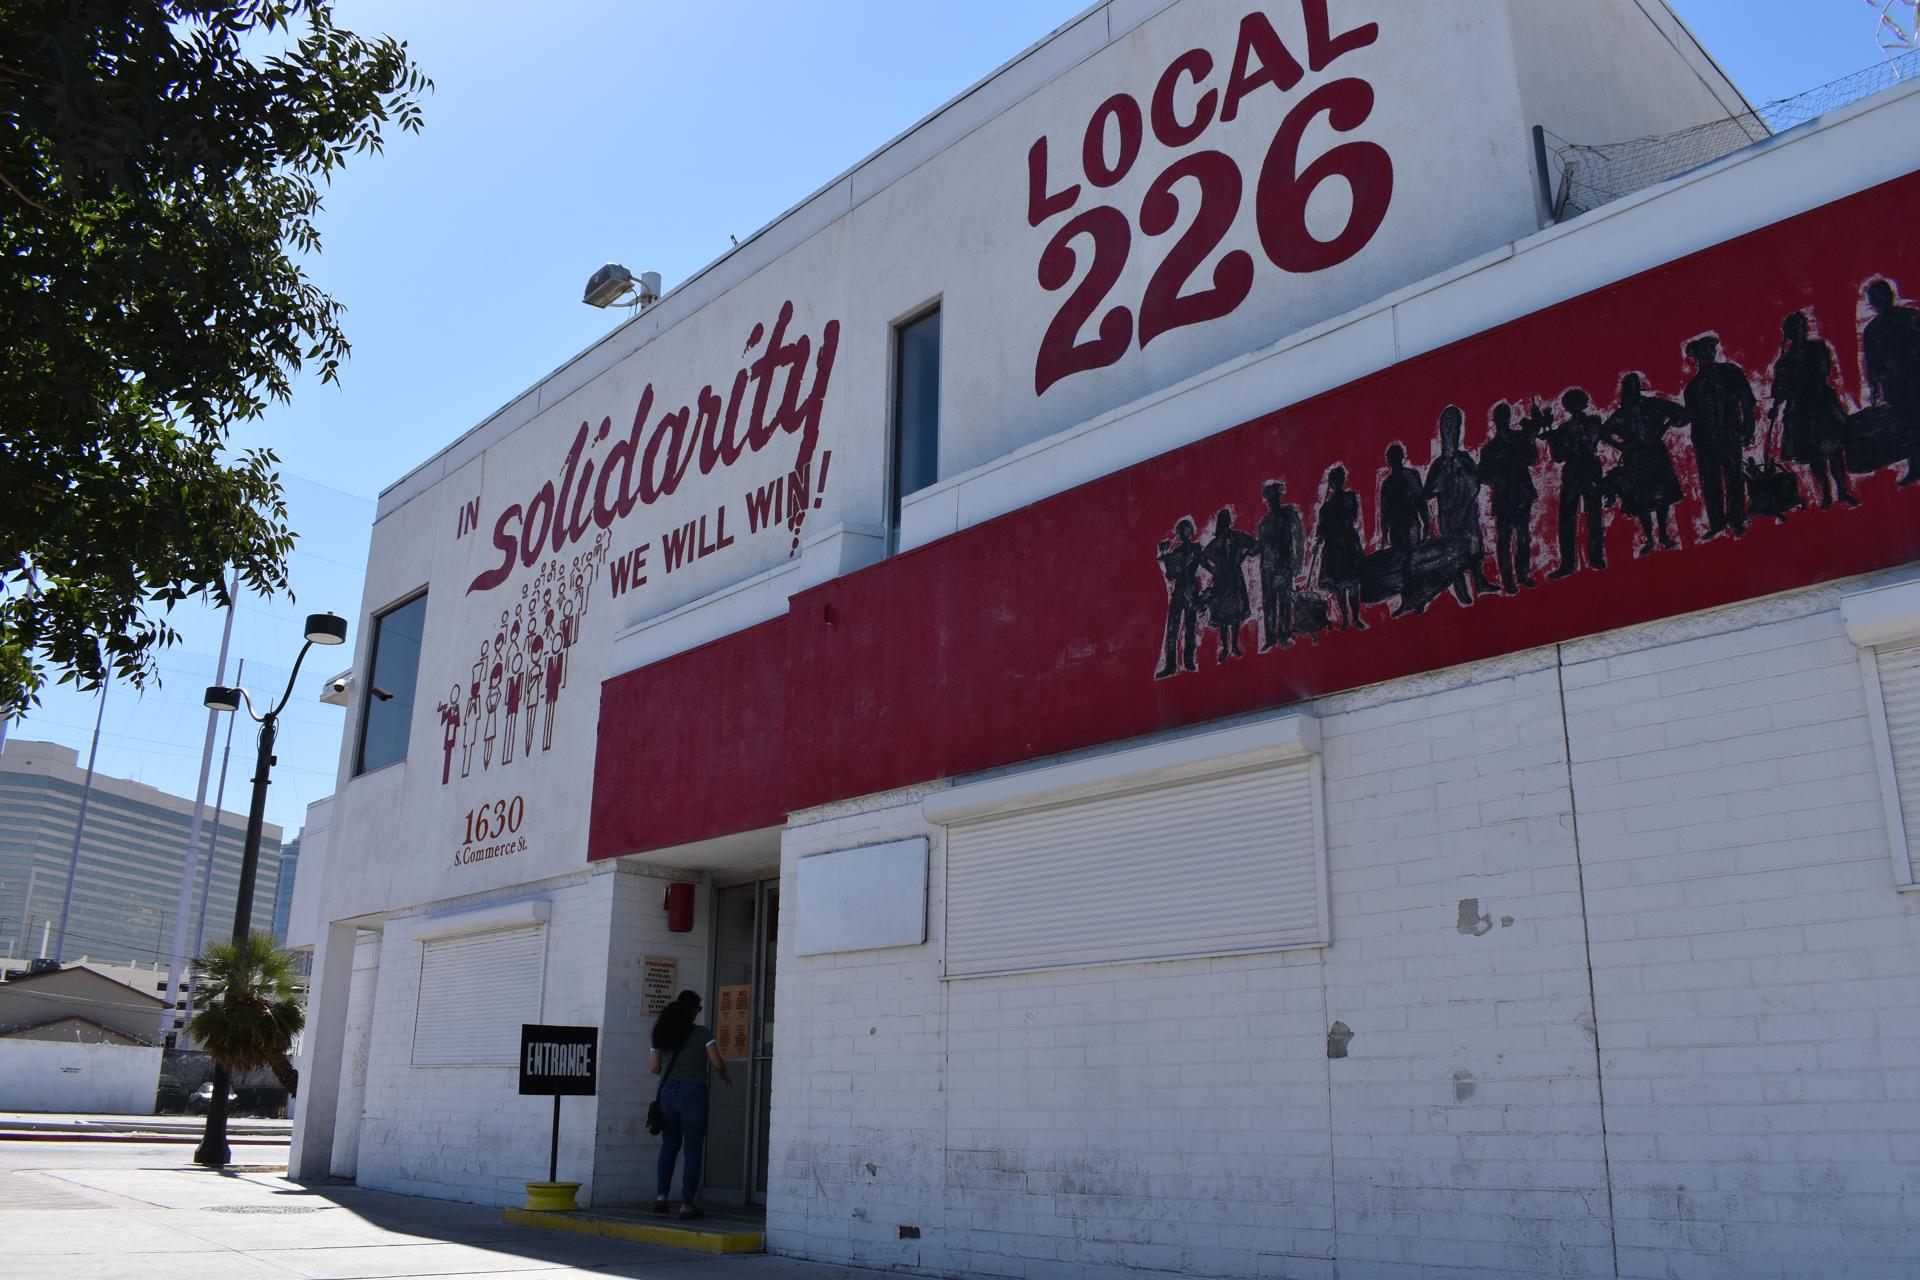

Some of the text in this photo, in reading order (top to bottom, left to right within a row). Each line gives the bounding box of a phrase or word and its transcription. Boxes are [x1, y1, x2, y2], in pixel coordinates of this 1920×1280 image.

[1028, 0, 1379, 227] LOCAL
[1034, 77, 1394, 397] 226
[456, 496, 480, 539] IN
[609, 450, 832, 599] WE WILL WIN!
[462, 795, 524, 846] 1630
[454, 836, 528, 866] S. Commerce St.
[526, 1042, 592, 1077] ENTRANCE
